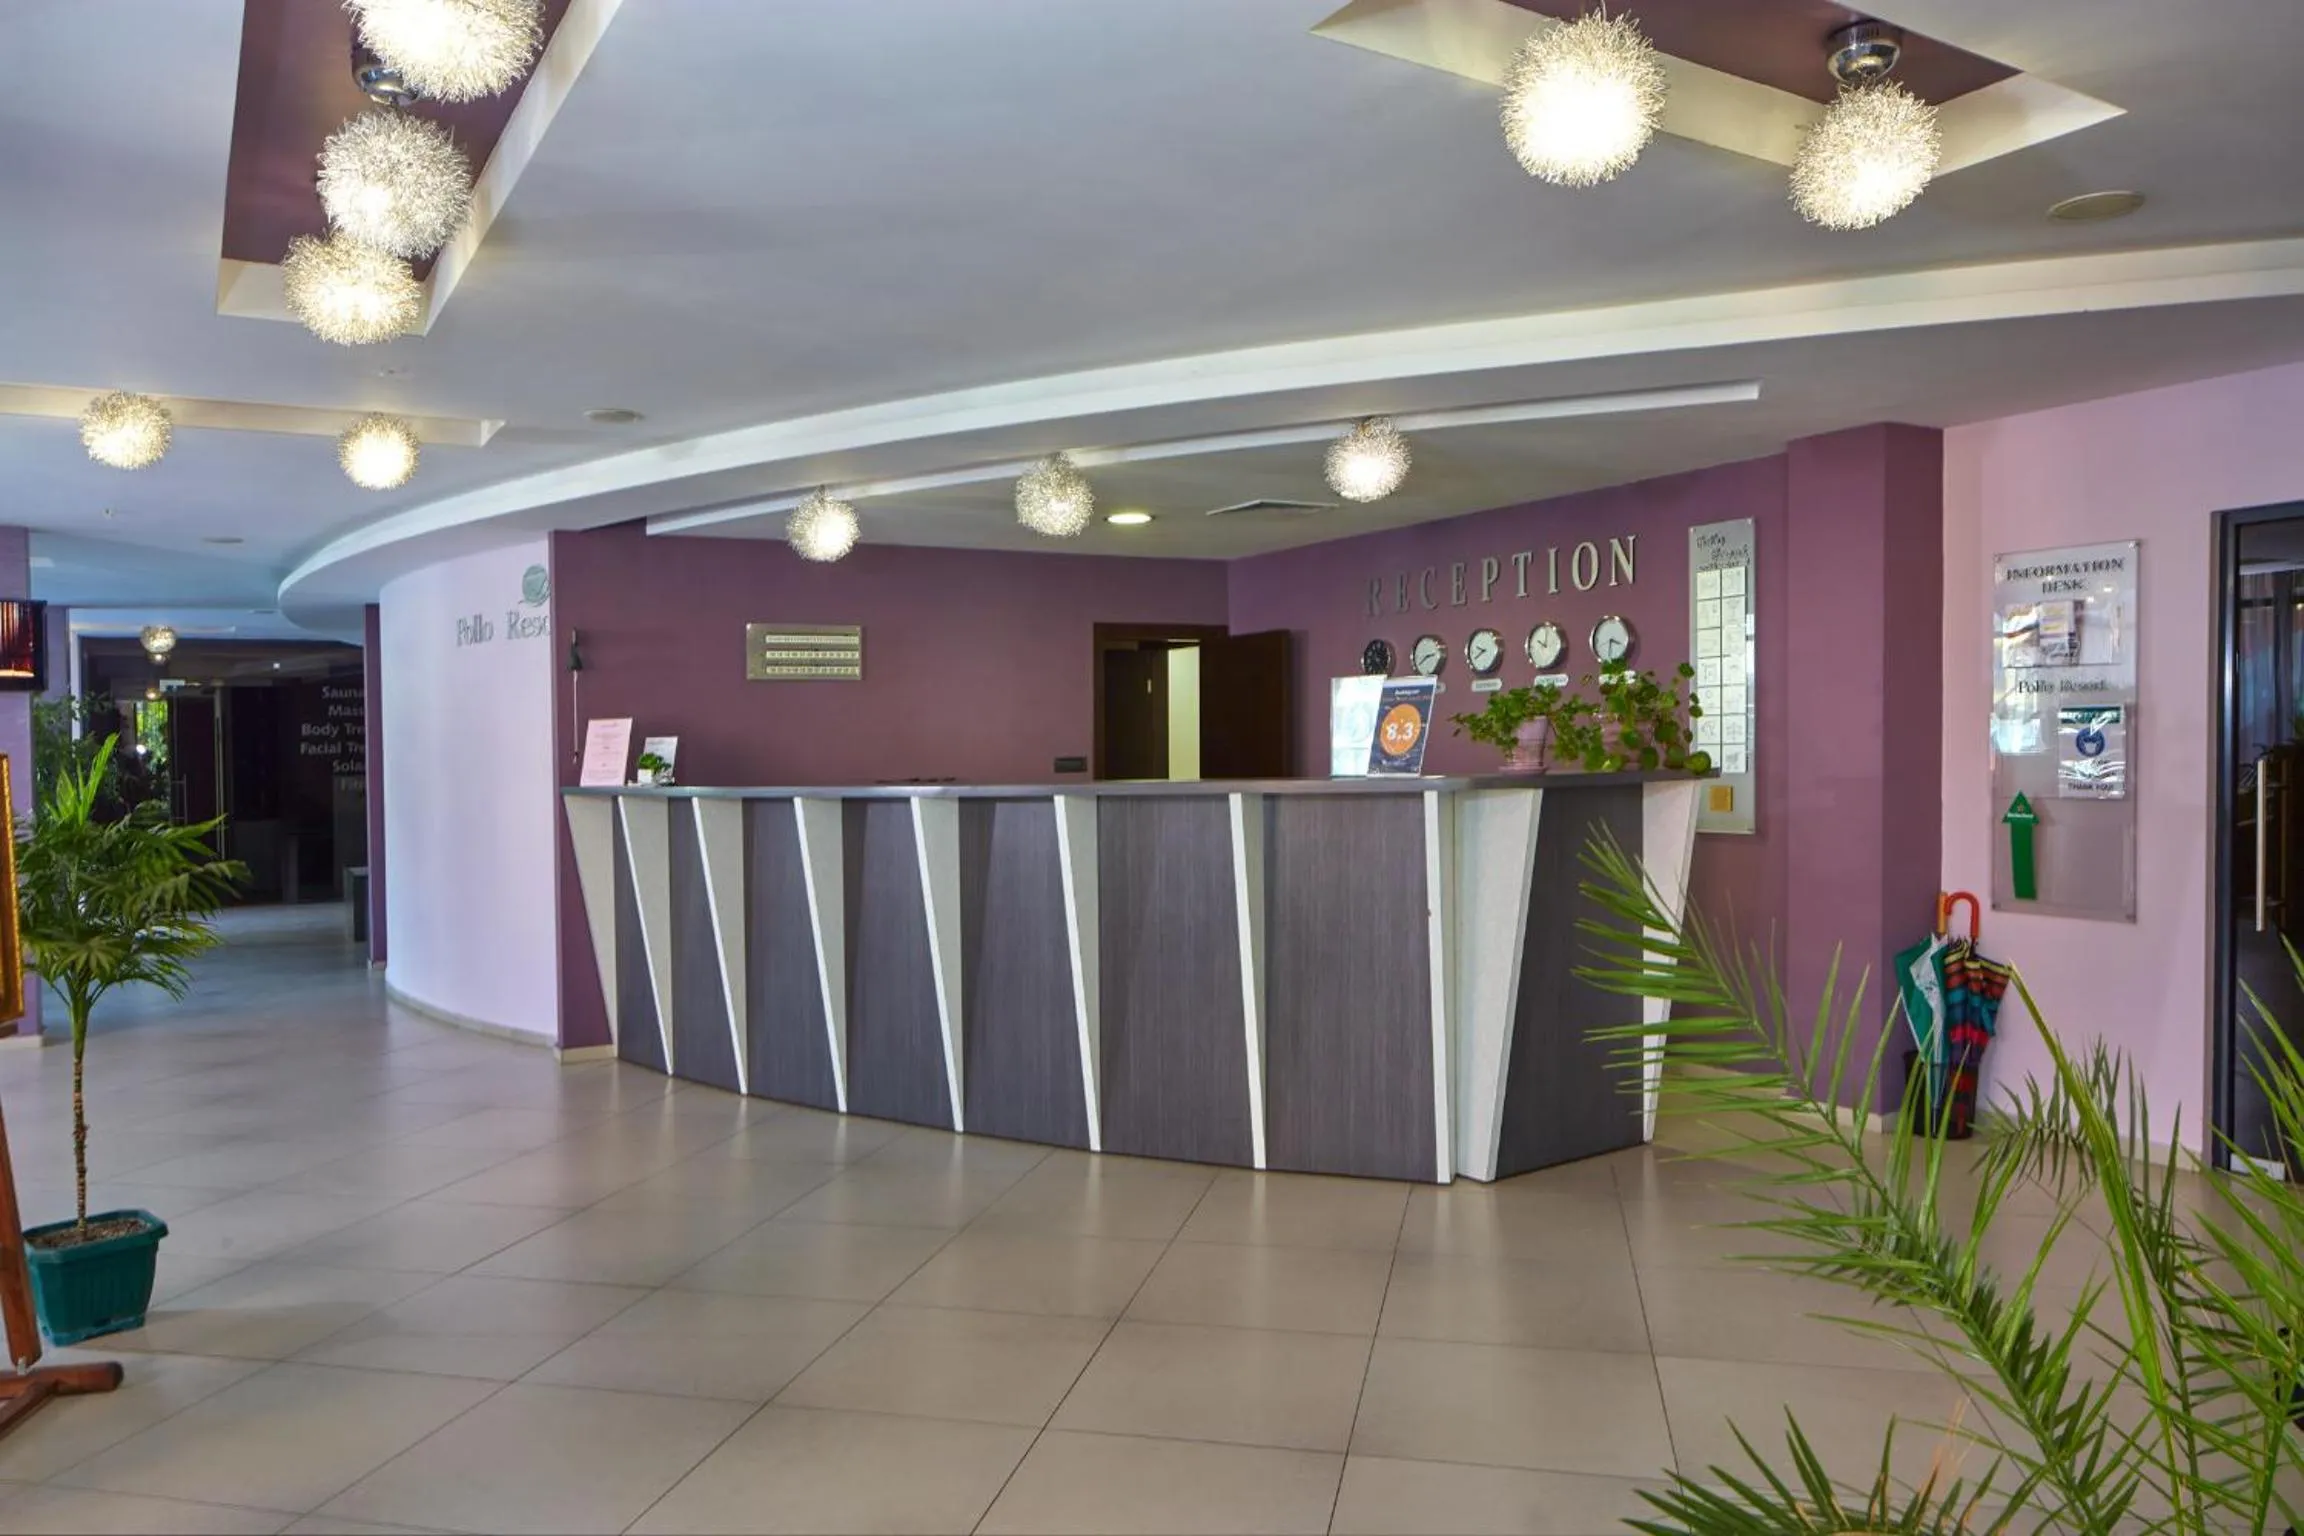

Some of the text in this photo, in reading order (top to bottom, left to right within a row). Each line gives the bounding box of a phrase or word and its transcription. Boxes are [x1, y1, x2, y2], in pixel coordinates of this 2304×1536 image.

[1366, 535, 1637, 617] RECEPTION
[2006, 558, 2124, 580] INFORMATION
[2042, 579, 2084, 593] DESK
[301, 722, 340, 737] Body
[300, 741, 342, 755] Facial
